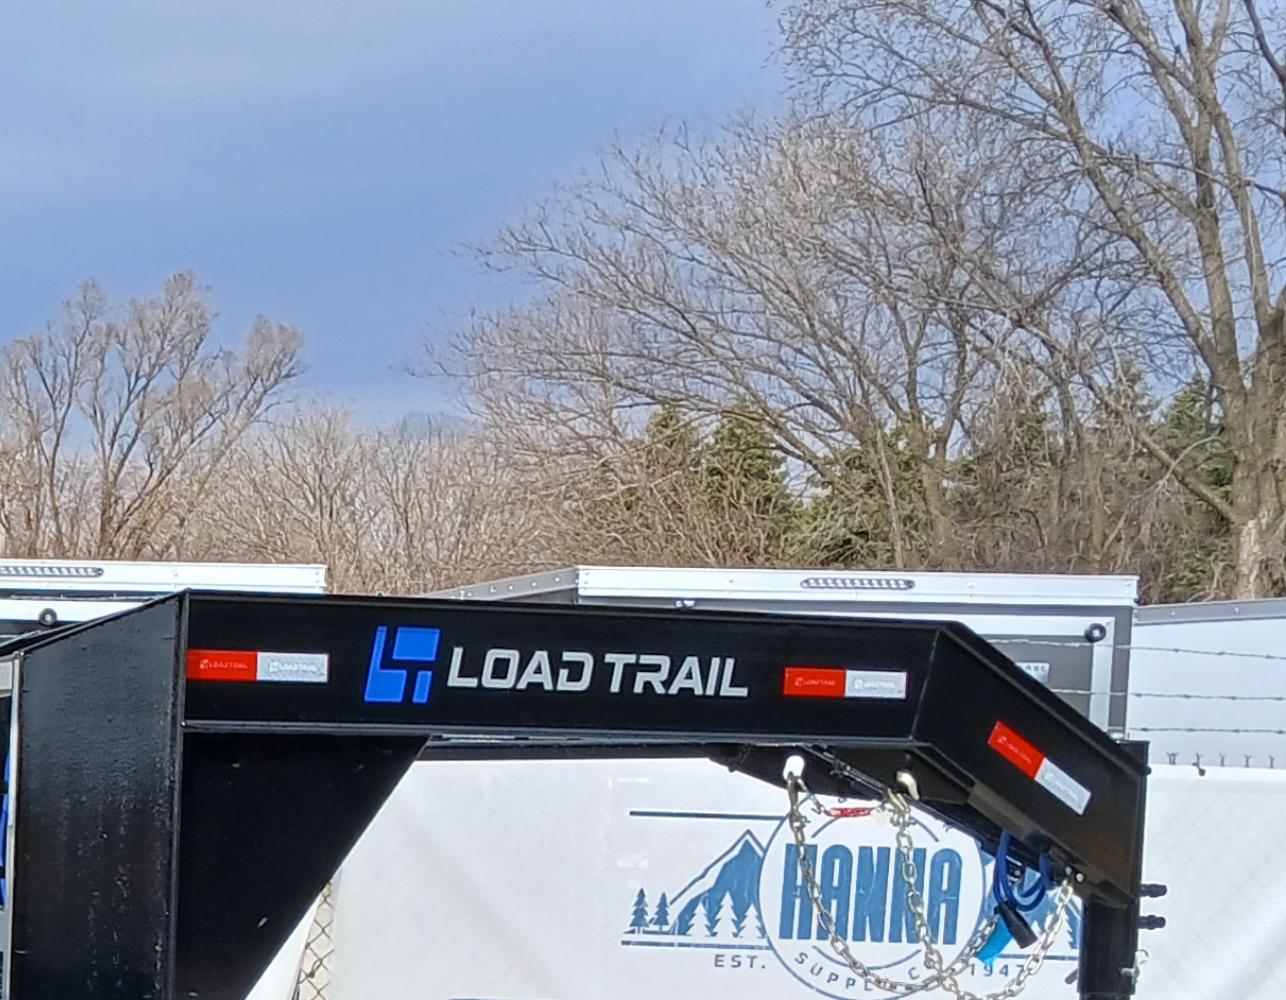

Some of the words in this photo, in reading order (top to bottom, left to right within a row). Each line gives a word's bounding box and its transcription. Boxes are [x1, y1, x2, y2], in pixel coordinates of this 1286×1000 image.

[447, 647, 595, 692] LOAD
[604, 653, 749, 698] TRAIL
[778, 843, 962, 945] HANNA
[714, 954, 766, 969] EST.
[794, 952, 874, 991] SUPPL
